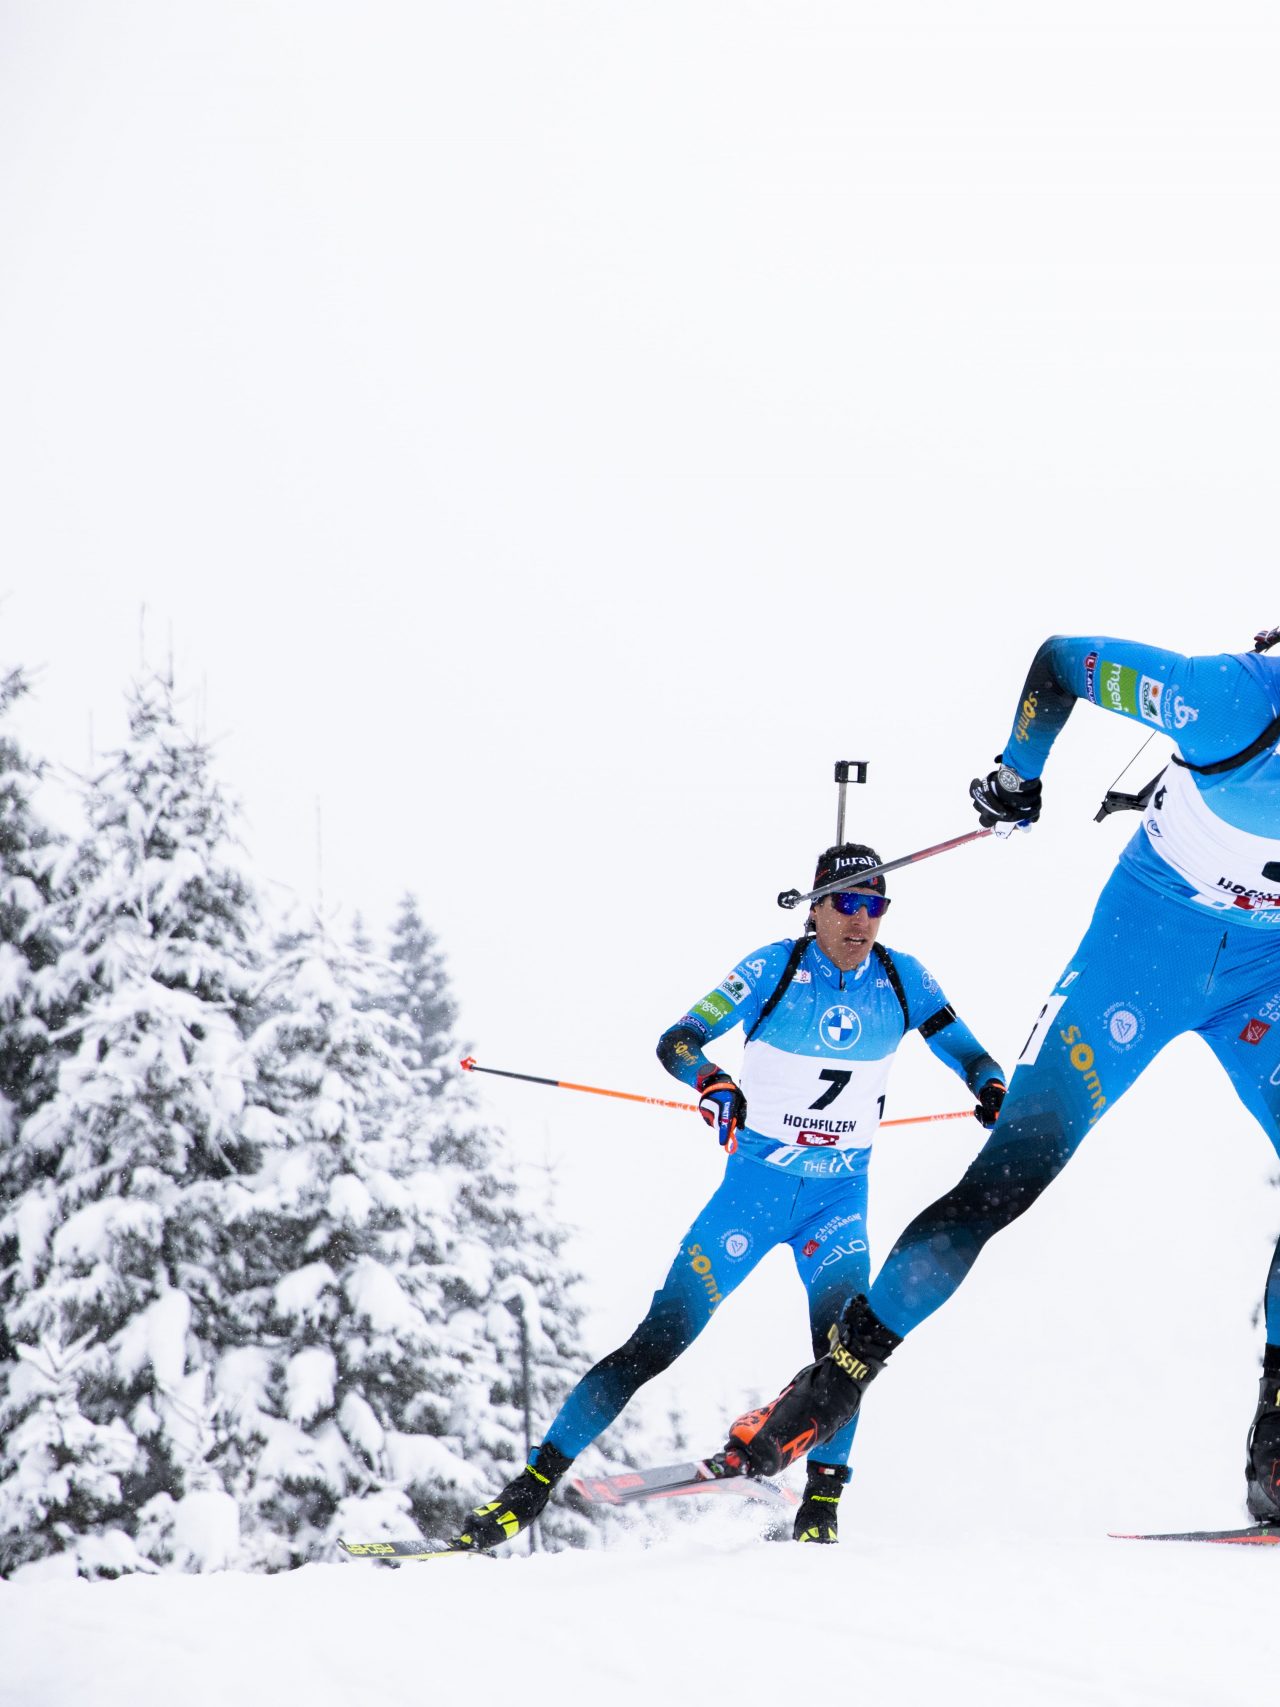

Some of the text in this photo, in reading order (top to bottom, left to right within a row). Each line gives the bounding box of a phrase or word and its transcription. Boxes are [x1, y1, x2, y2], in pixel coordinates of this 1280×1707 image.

[1106, 663, 1123, 711] mgen
[826, 1007, 856, 1022] BMW
[807, 1068, 853, 1111] 7
[783, 1113, 857, 1133] HOCHFILZEN
[803, 1160, 827, 1174] THE
